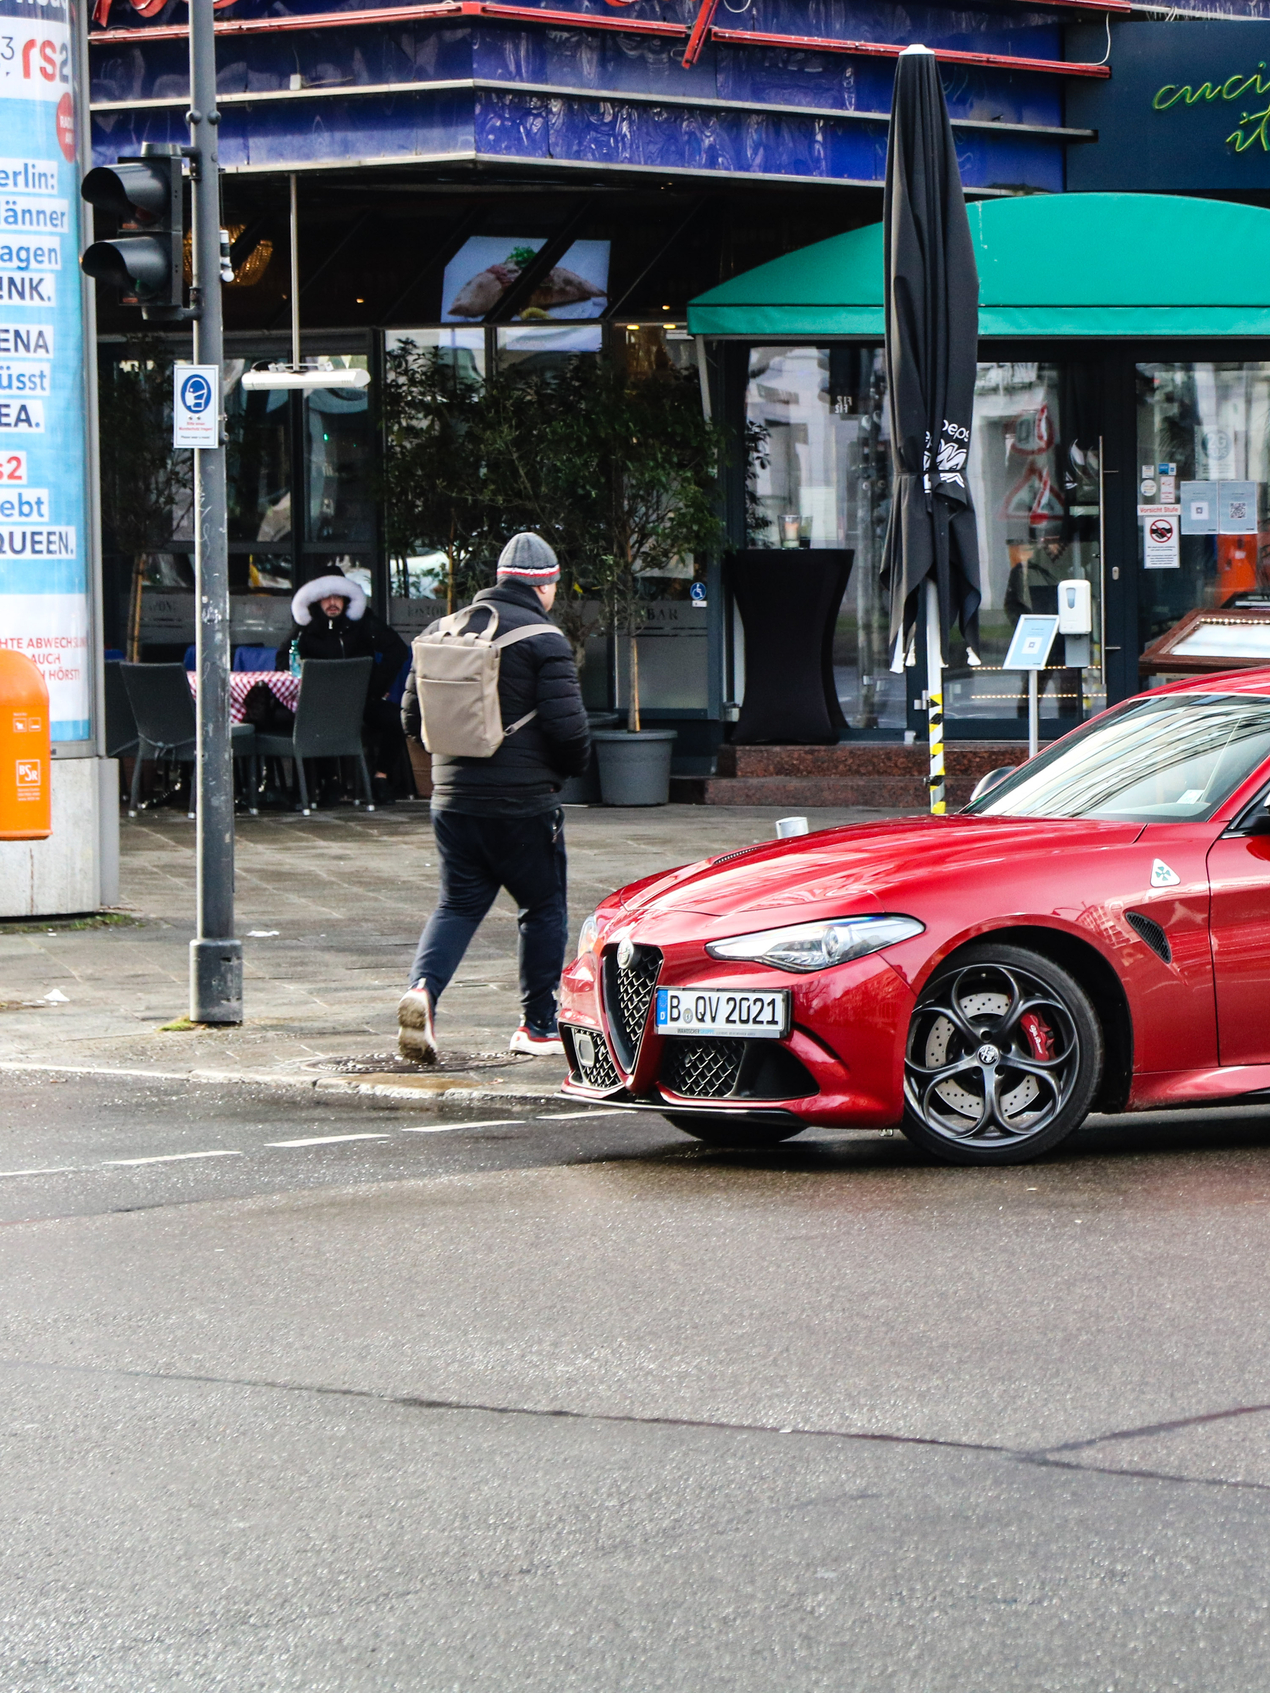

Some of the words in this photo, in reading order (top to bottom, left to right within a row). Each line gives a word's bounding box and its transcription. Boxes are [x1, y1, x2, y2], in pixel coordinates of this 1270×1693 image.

[22, 38, 70, 85] rs2
[0, 163, 55, 190] erlin:
[0, 200, 66, 228] änner
[0, 245, 59, 271] agen
[0, 276, 52, 302] !NK.
[0, 329, 50, 354] ENA
[0, 365, 47, 391] üsst
[0, 404, 41, 428] EA.
[942, 419, 970, 442] eps
[0, 493, 44, 518] ebt
[647, 608, 678, 620] BAR
[0, 638, 24, 649] HTE
[49, 667, 80, 681] HÖRST!
[19, 764, 38, 781] BSR
[660, 1011, 666, 1020] D
[669, 995, 681, 1022] B
[695, 995, 720, 1023] QV
[725, 997, 779, 1025] 2021
